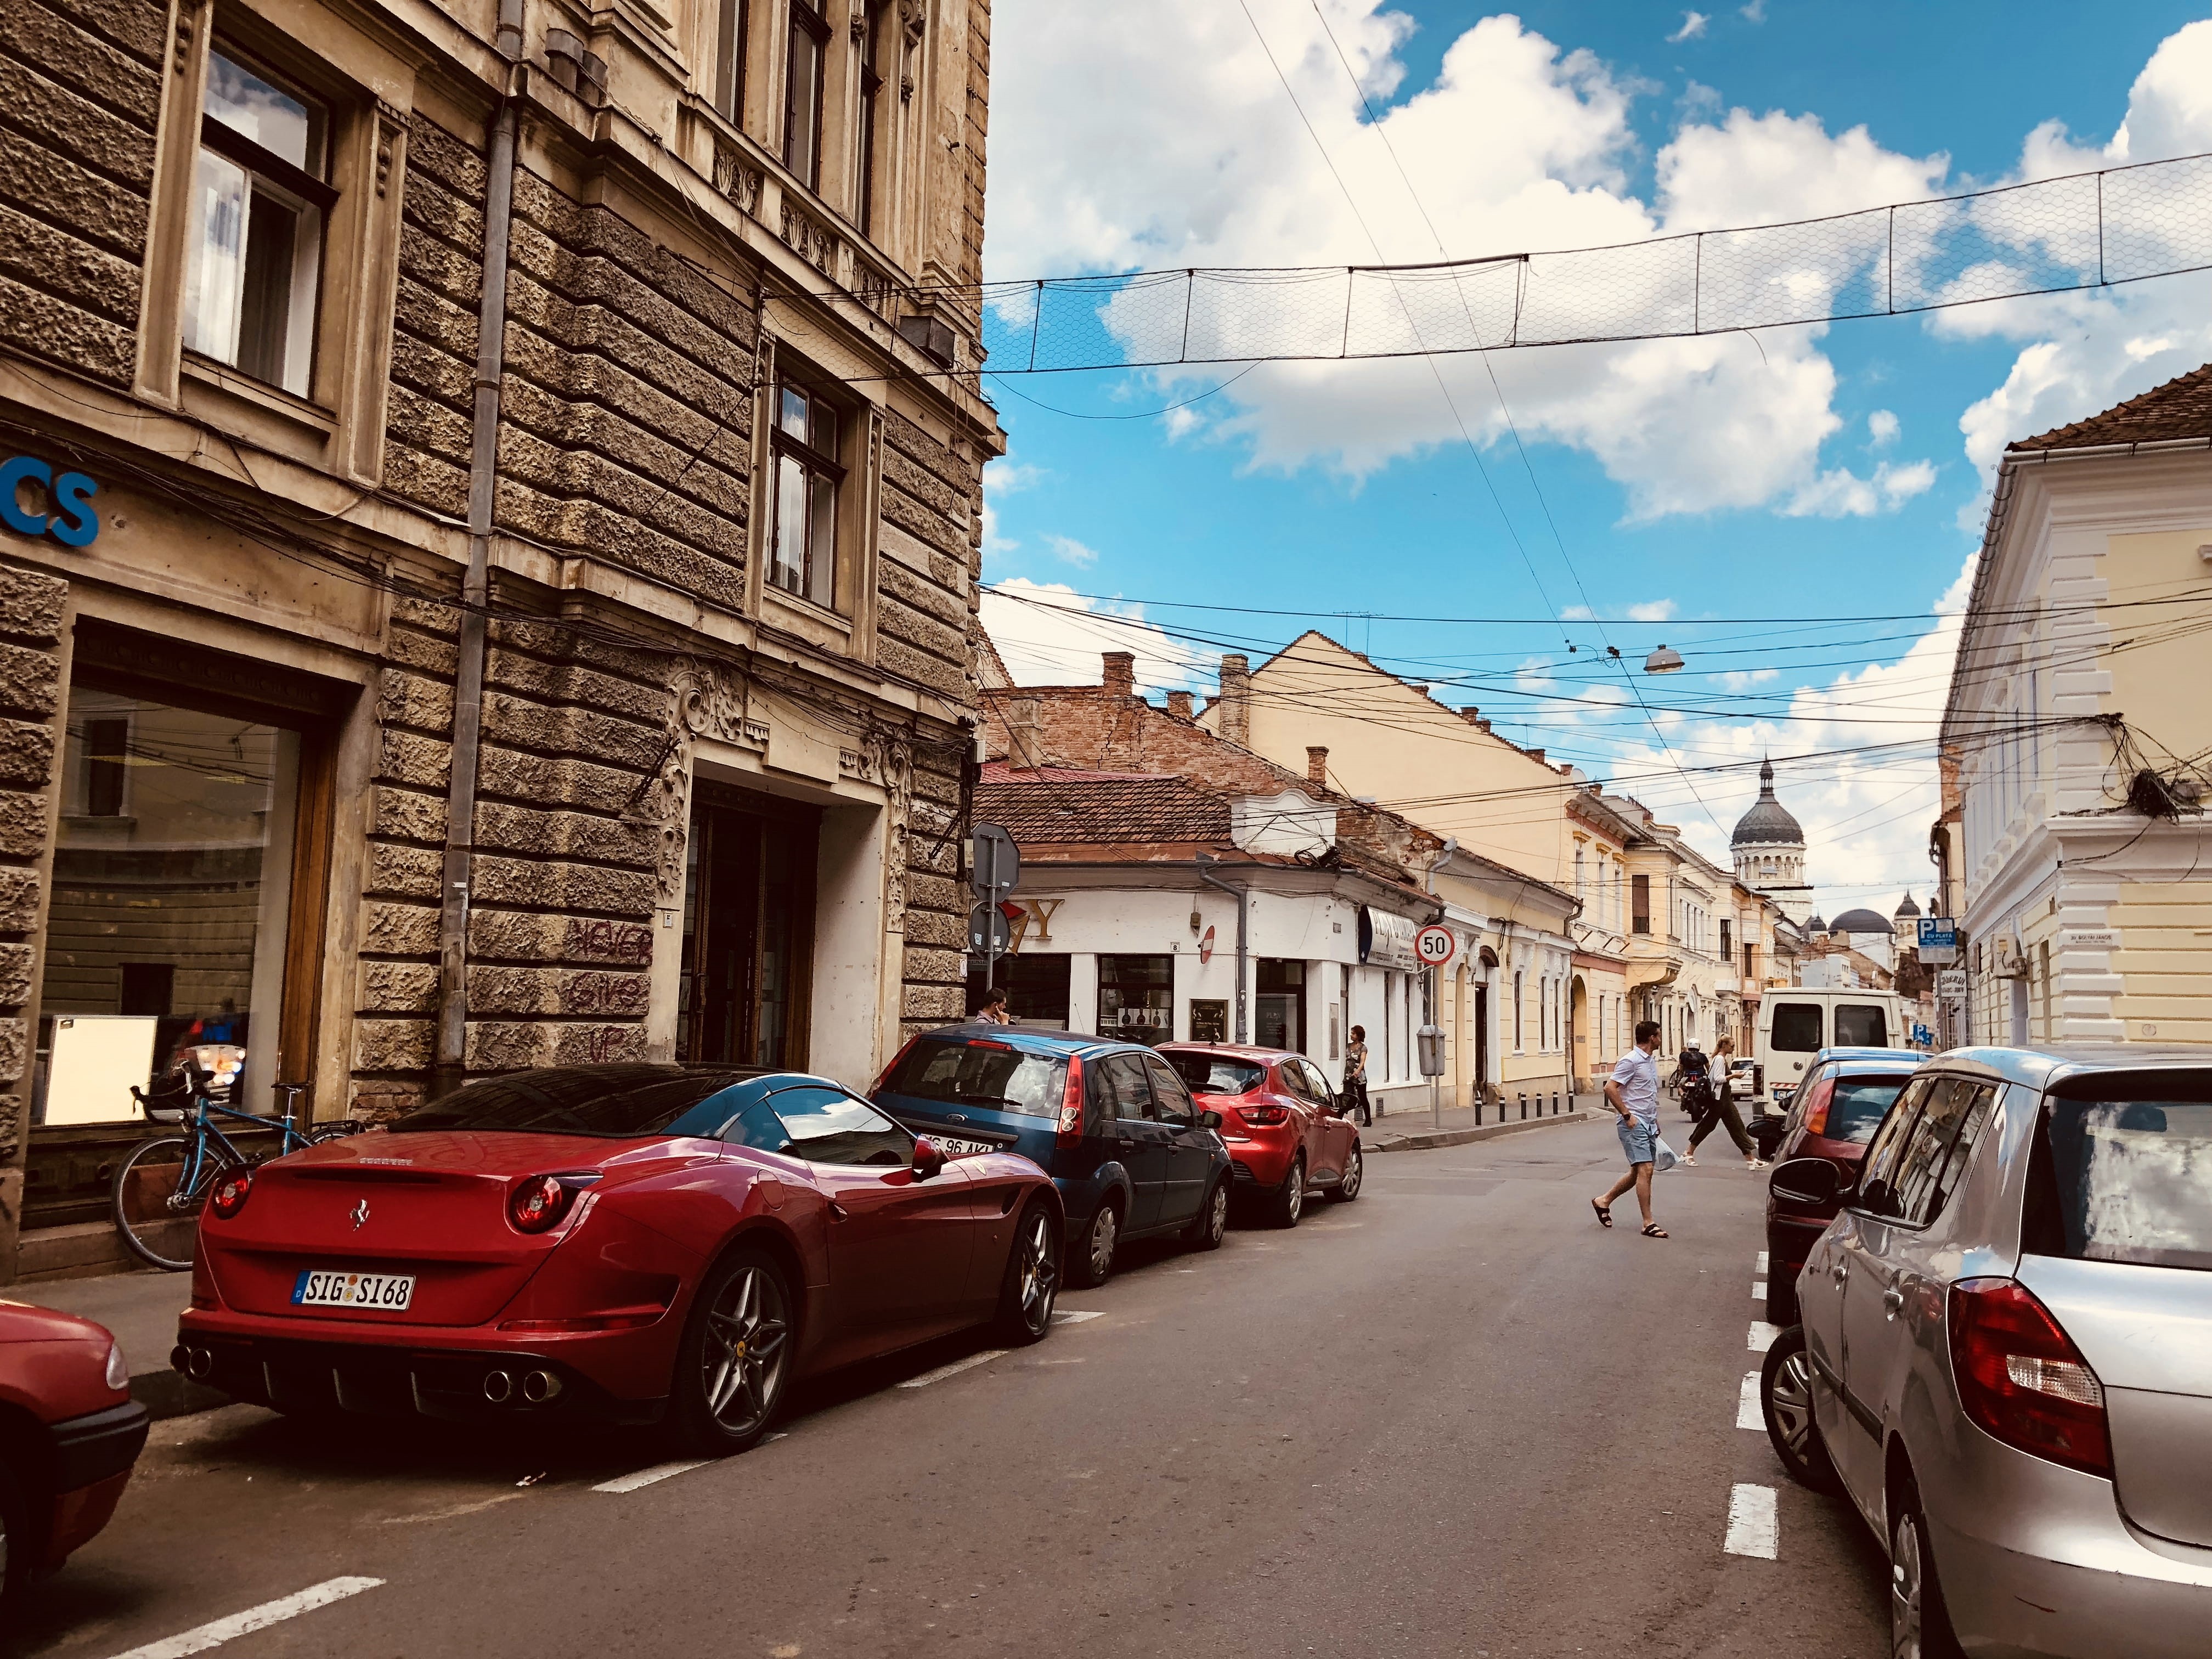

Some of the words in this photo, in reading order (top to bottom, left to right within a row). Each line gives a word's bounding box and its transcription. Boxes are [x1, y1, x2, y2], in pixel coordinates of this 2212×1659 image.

[0, 456, 99, 547] CS
[1424, 936, 1445, 954] 50
[946, 1139, 963, 1153] 96
[306, 1274, 346, 1301] SIG
